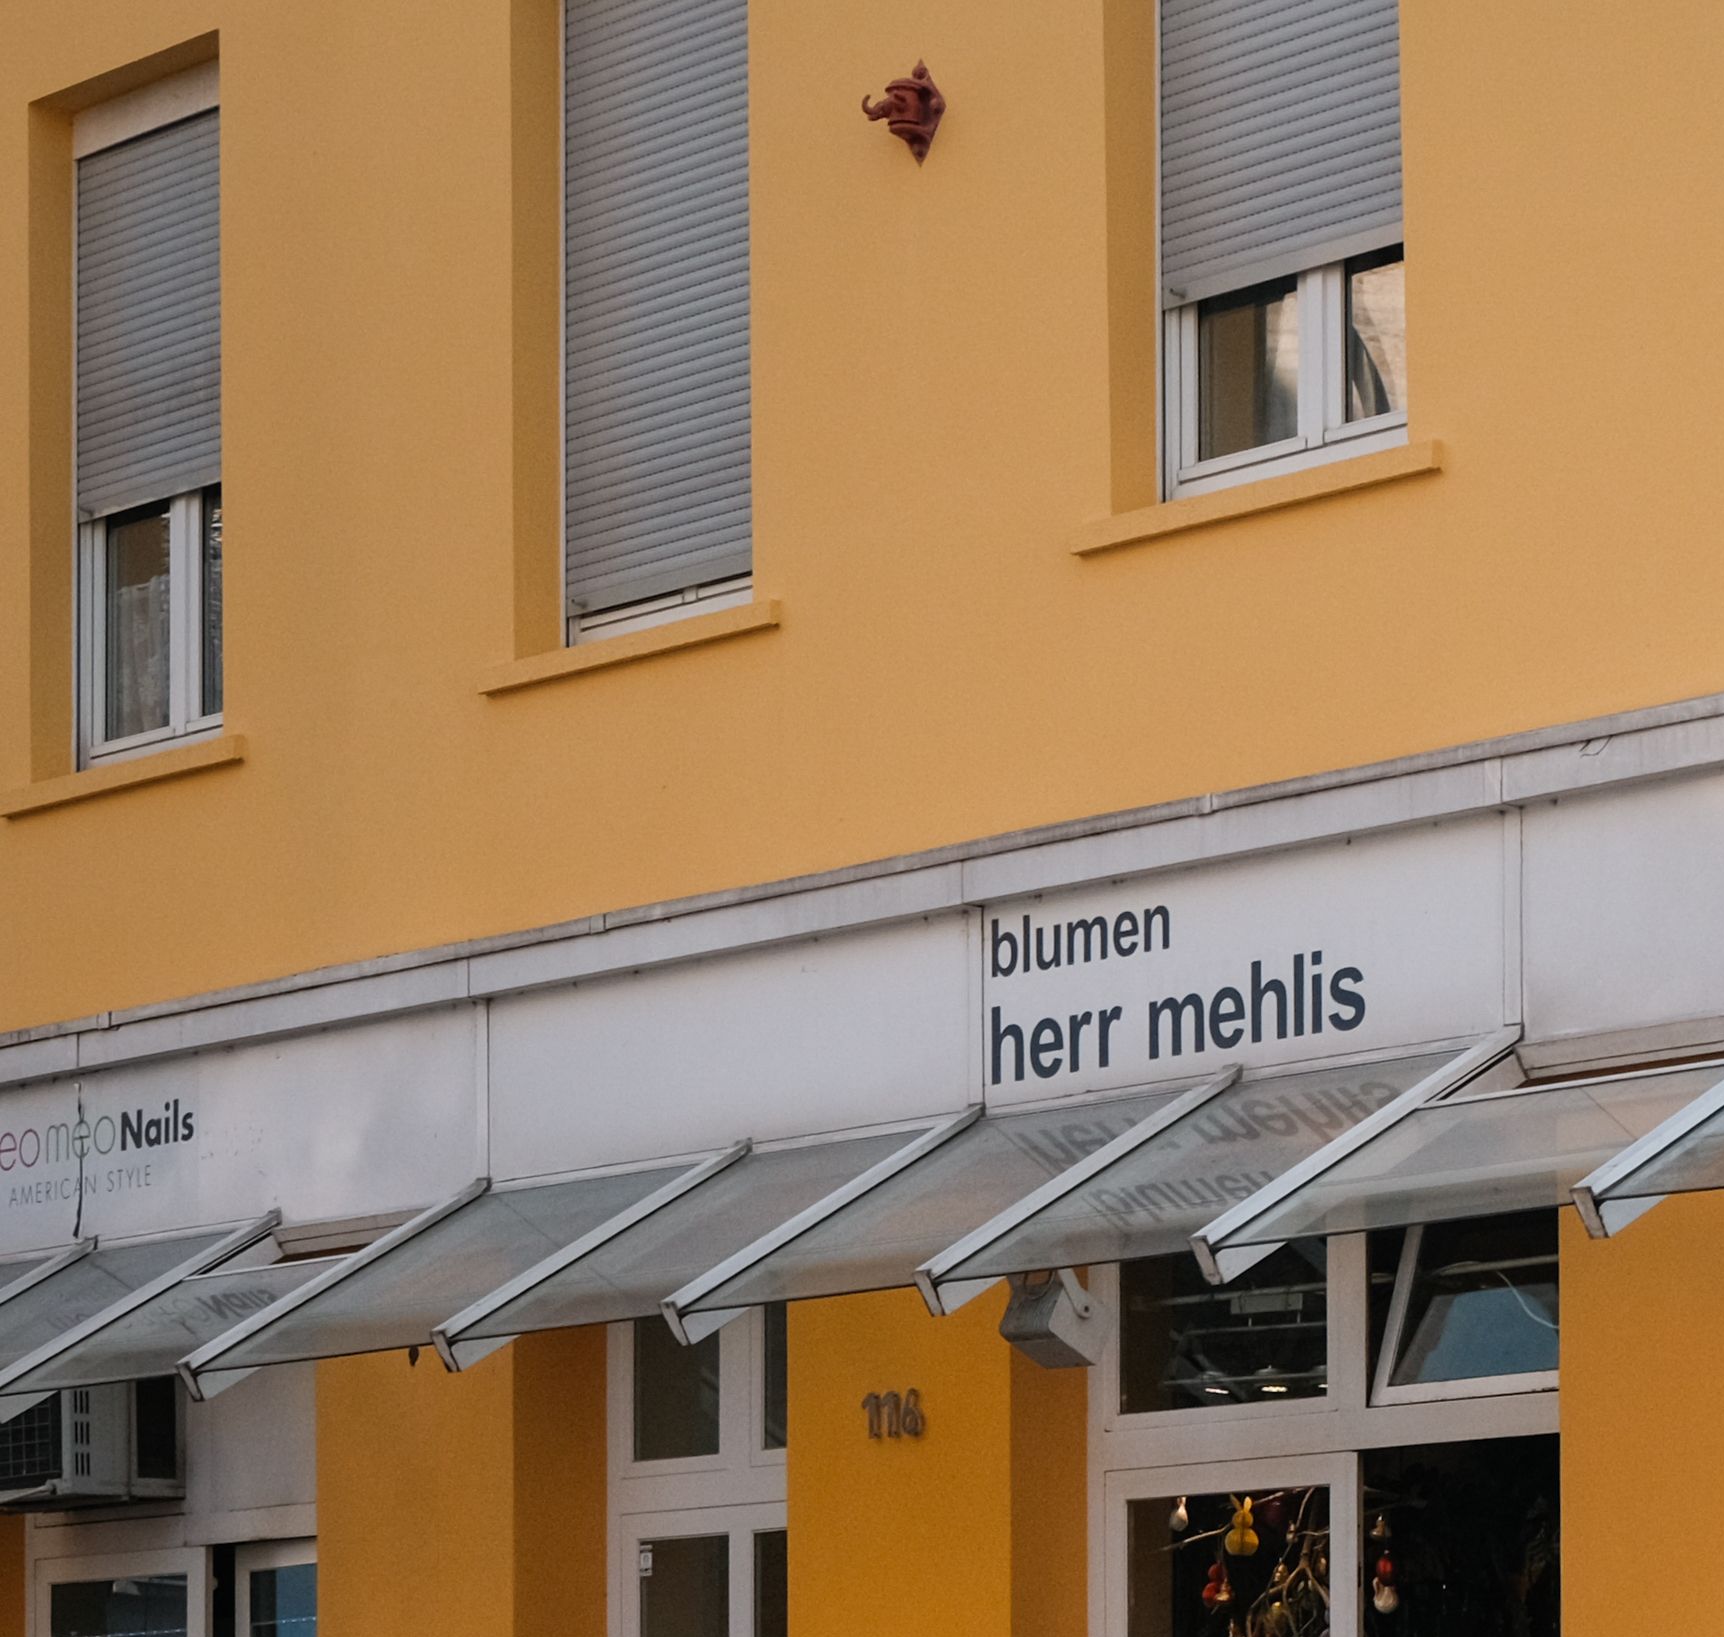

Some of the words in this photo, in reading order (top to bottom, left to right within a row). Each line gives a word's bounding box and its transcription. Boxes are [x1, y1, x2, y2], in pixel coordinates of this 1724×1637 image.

[991, 904, 1170, 978] blumen
[992, 1005, 1123, 1086] herr
[1148, 950, 1366, 1060] mehlis
[121, 1098, 194, 1153] Nails
[9, 1174, 97, 1208] AMERICAN
[106, 1164, 151, 1193] STYLE
